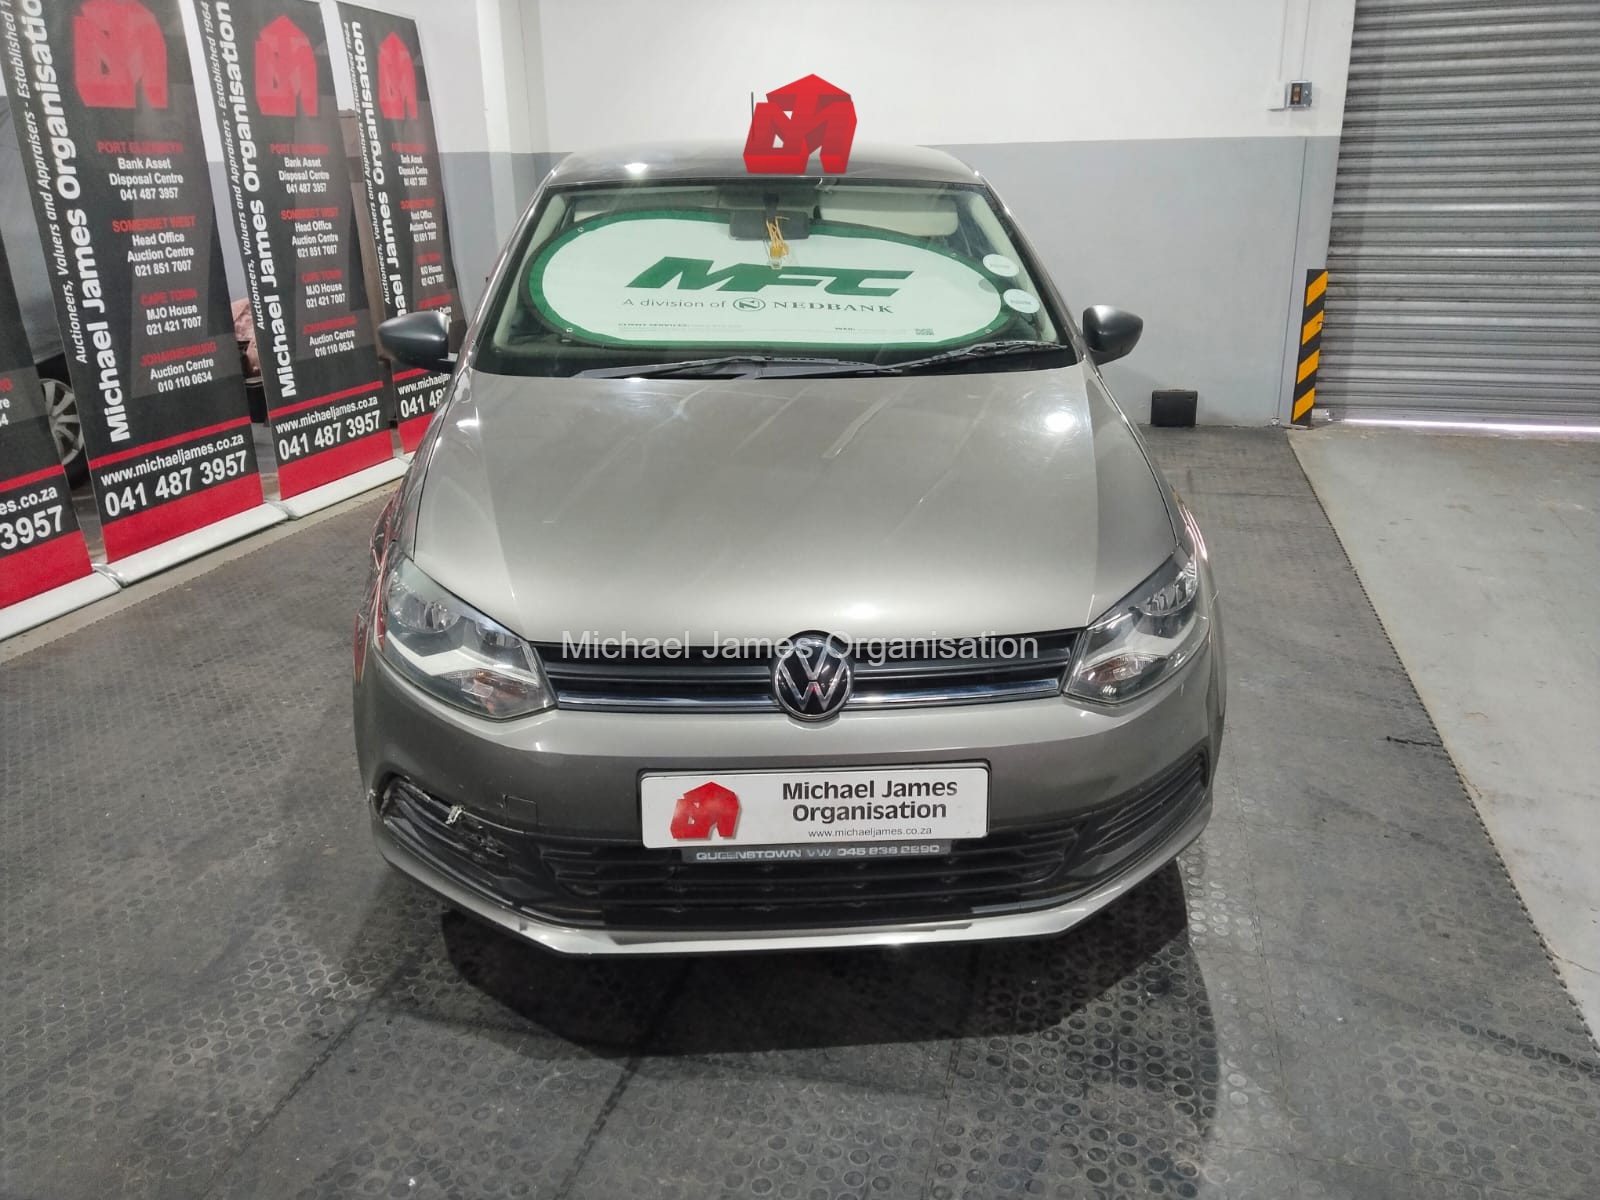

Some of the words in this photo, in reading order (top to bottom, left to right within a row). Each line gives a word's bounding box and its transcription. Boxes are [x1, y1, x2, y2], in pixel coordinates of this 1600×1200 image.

[1, 10, 31, 99] Established
[206, 35, 227, 109] Established
[20, 0, 81, 200] Organisatio
[215, 1, 260, 192] Organisation
[351, 21, 385, 185] Organisation
[24, 111, 52, 190] Appraisers
[117, 157, 144, 170] Bank
[145, 157, 172, 169] Asset
[222, 119, 240, 184] Appraisers
[108, 172, 153, 188] Disposal
[153, 172, 184, 185] Centre
[120, 188, 138, 201] 041
[139, 187, 156, 200] 487
[232, 184, 244, 209] and
[39, 190, 57, 221] and
[49, 223, 69, 276] Valuers
[132, 233, 157, 246] Head
[158, 231, 185, 245] Office
[238, 212, 252, 256] Valuers
[249, 199, 277, 288] James
[377, 191, 399, 269] James
[66, 208, 105, 314] James
[127, 249, 164, 262] Auction
[165, 246, 195, 258] Centre
[134, 264, 152, 277] 021
[153, 261, 170, 274] 851
[171, 259, 192, 273] 7007
[247, 259, 265, 331] Auctioneers,
[625, 256, 915, 297] MFC
[62, 280, 88, 364] Auctioneers,
[146, 307, 167, 320] MJO
[168, 304, 198, 317] House
[146, 323, 163, 336] 021
[164, 319, 180, 332] 421
[181, 315, 202, 329] 7007
[622, 298, 635, 308] A
[640, 297, 711, 309] division
[713, 298, 727, 309] of
[773, 300, 894, 314] NEDBANK
[263, 294, 297, 398] Michael
[86, 320, 131, 443] Michael
[150, 364, 185, 380] Auction
[185, 357, 215, 372] Centre
[157, 379, 174, 393] 010
[175, 375, 191, 389] 110
[191, 370, 213, 385] 0634
[275, 396, 378, 435] www.michaeljames.co.za
[400, 394, 425, 418] 041
[278, 432, 310, 461] 041
[314, 421, 342, 448] 487
[346, 409, 381, 438] 3957
[100, 433, 244, 487] www.michaeljames.co.za
[0, 486, 58, 515] es.co.za
[104, 481, 147, 517] 041
[155, 466, 193, 499] 487
[199, 449, 247, 485] 3957
[0, 504, 63, 550] 3957
[782, 780, 875, 801] Michael
[881, 780, 958, 799] James
[792, 801, 948, 825] Organisation
[808, 826, 932, 838] www.michaeljames.co.za
[806, 848, 832, 858] VW
